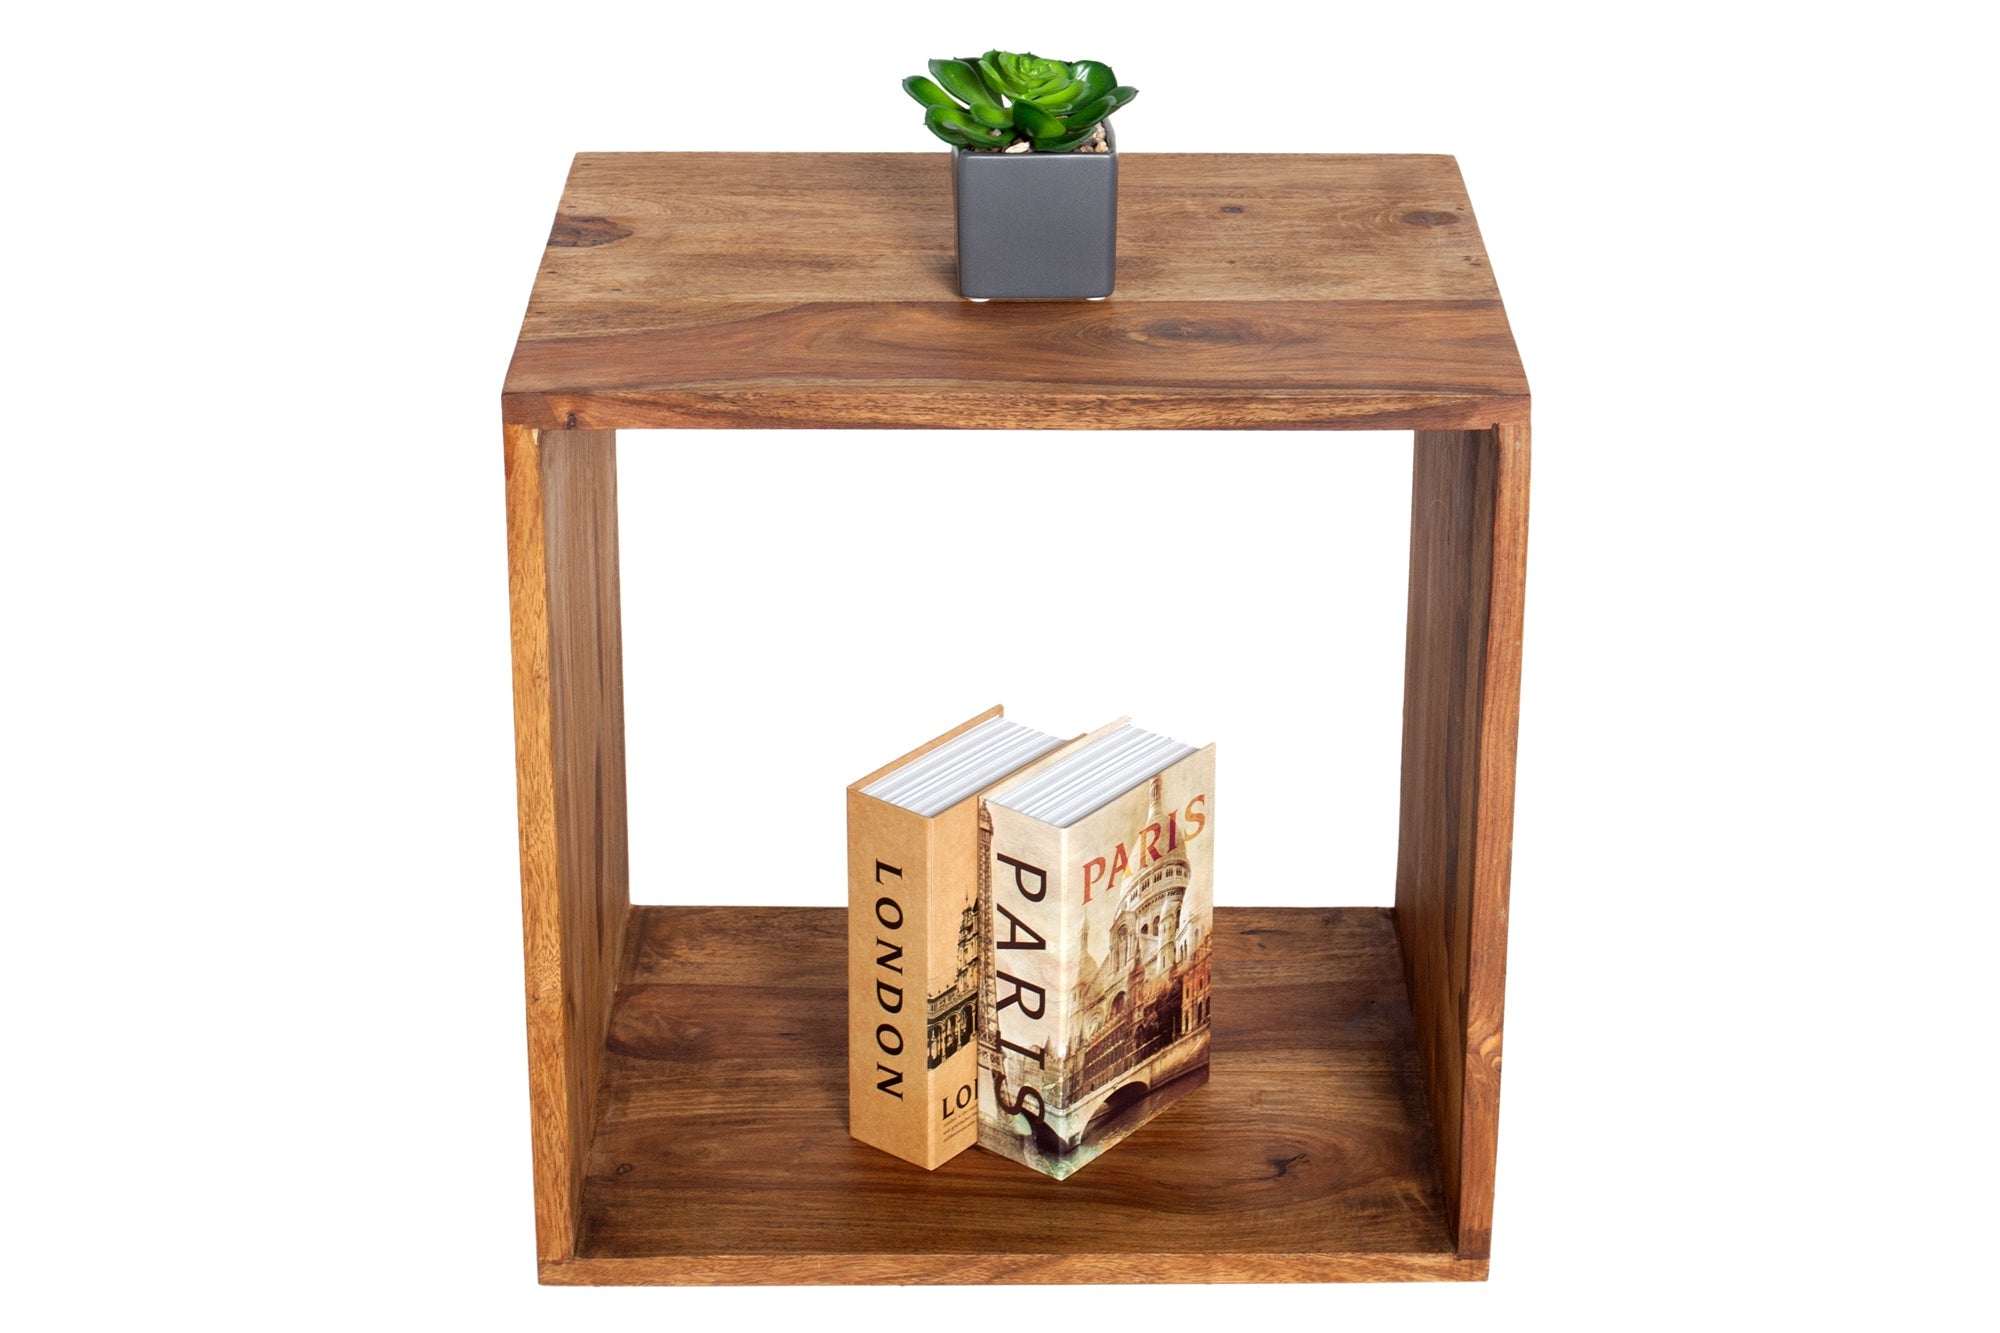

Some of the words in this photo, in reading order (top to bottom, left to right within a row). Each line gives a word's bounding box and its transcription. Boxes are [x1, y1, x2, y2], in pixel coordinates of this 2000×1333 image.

[1082, 794, 1206, 905] PARIS
[875, 858, 904, 1101] LONDON
[996, 852, 1047, 1125] PARIS
